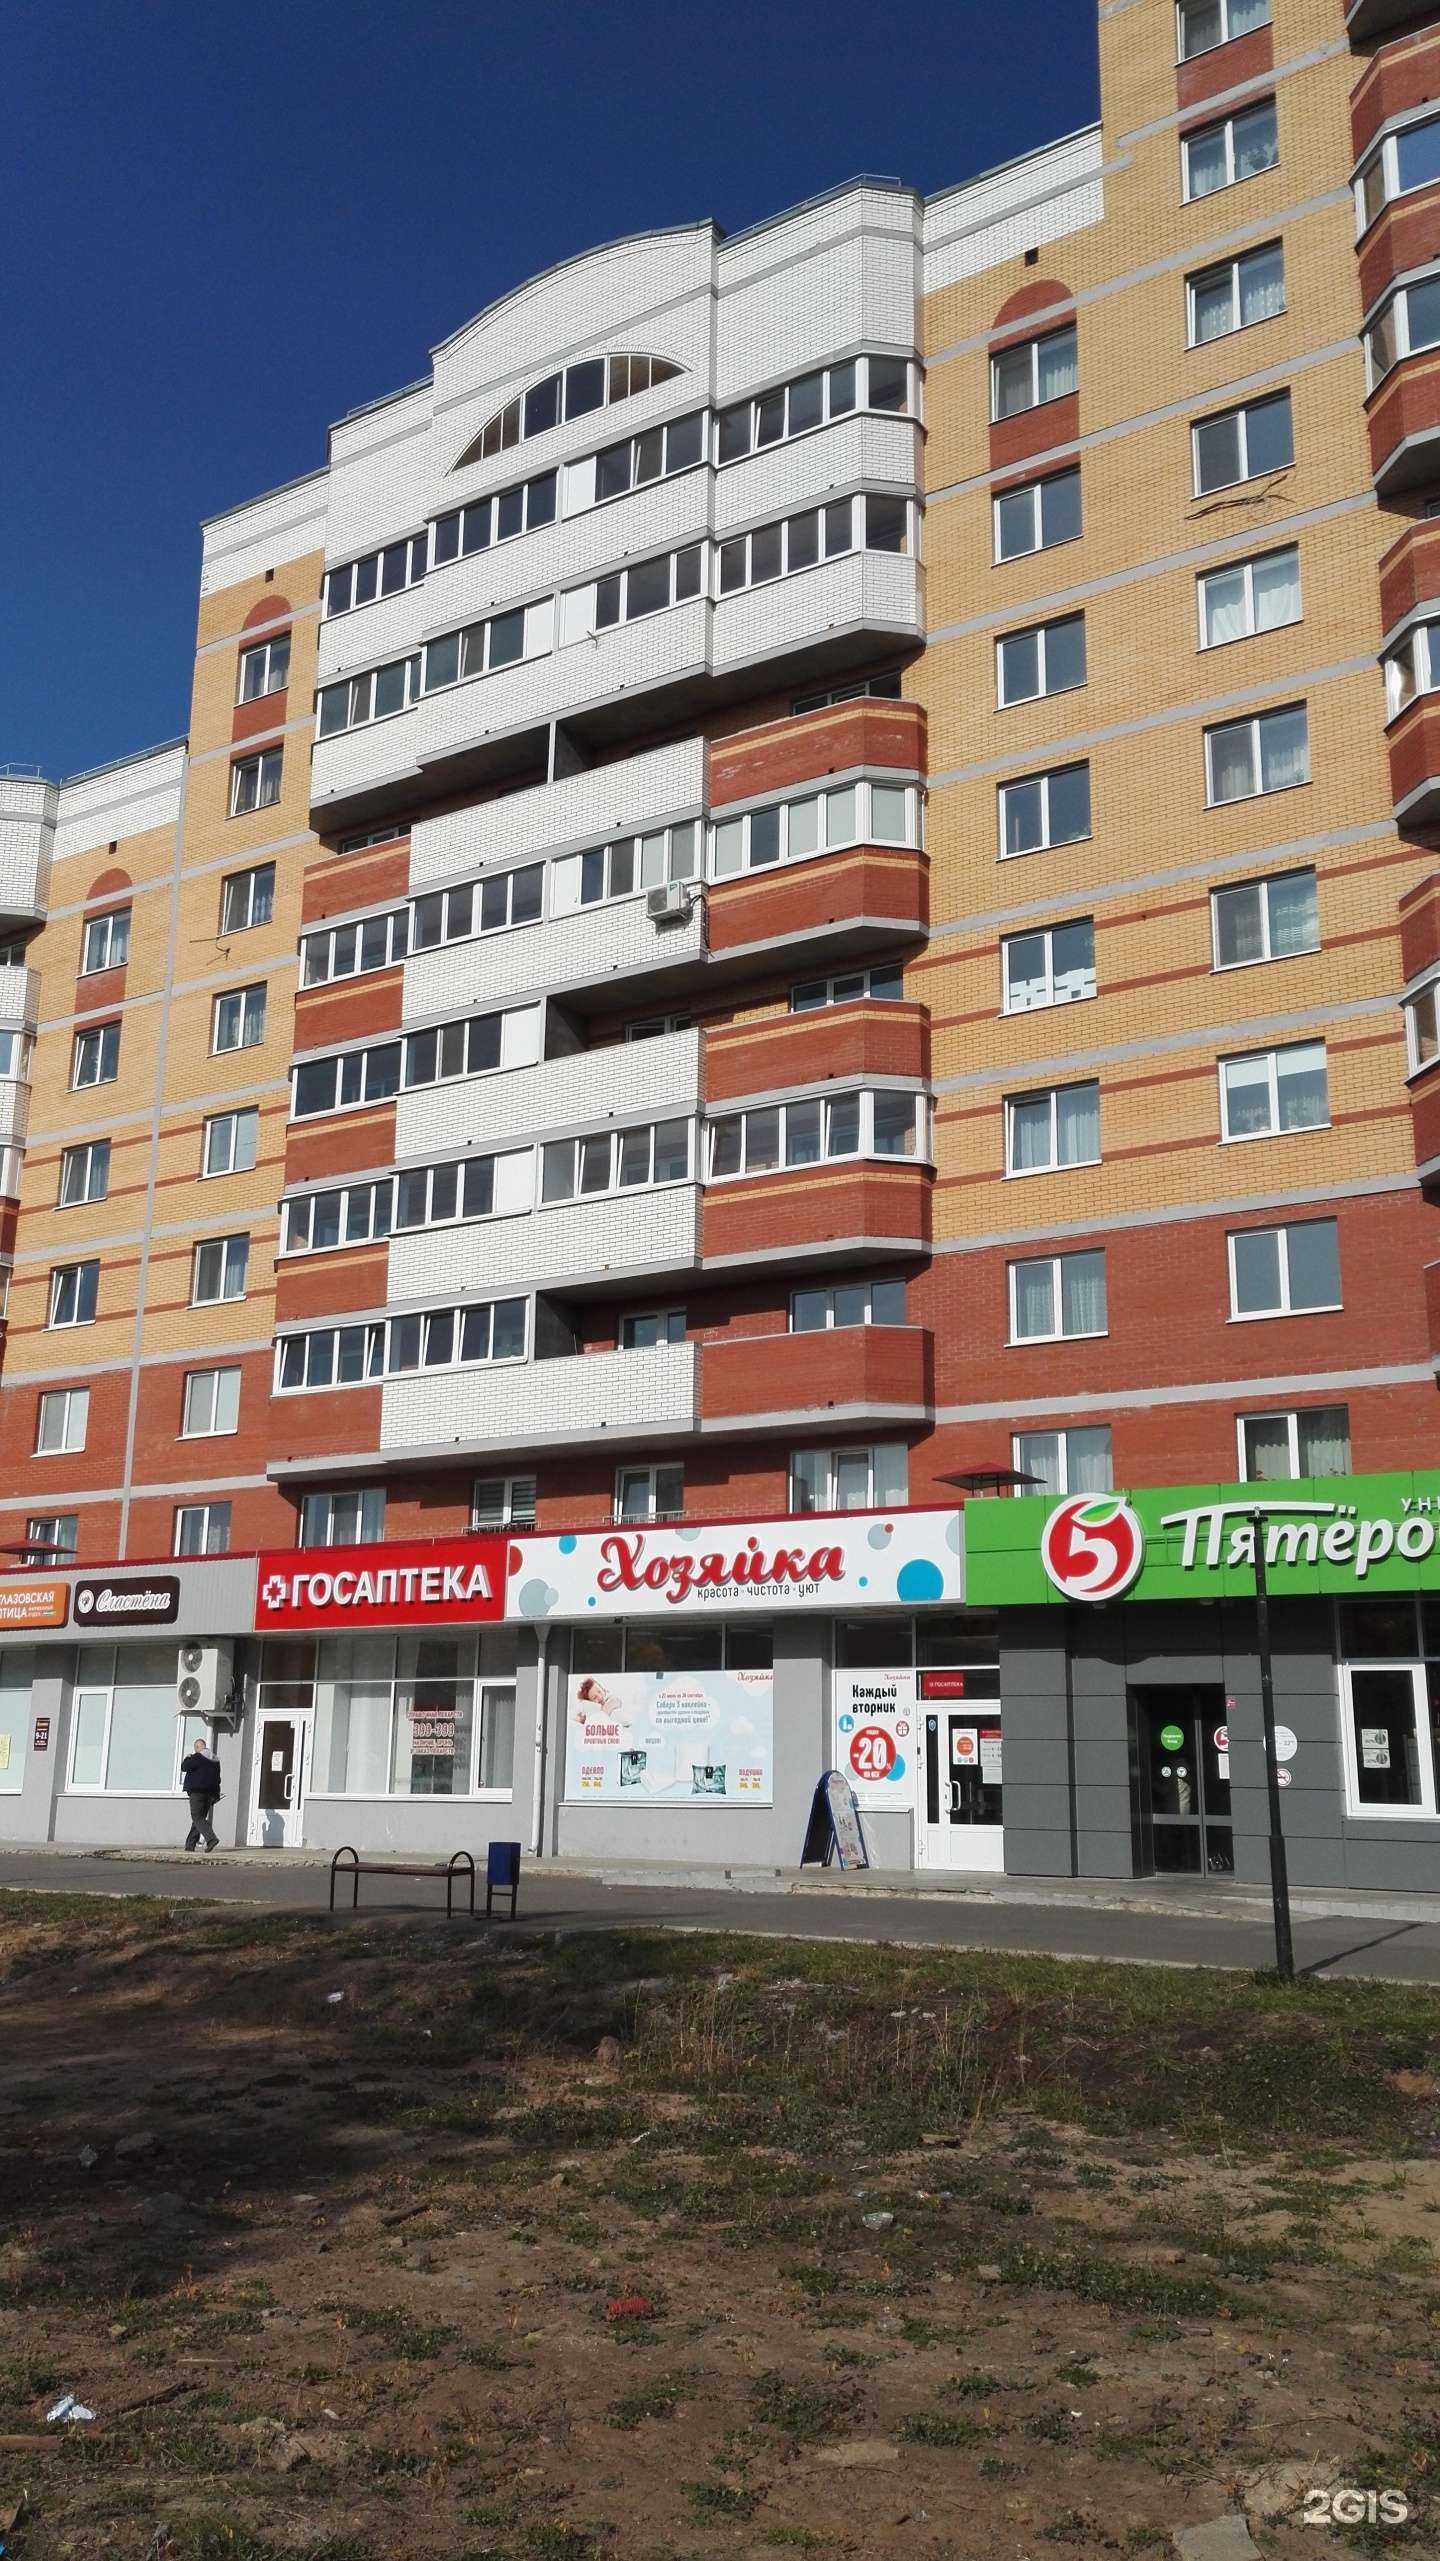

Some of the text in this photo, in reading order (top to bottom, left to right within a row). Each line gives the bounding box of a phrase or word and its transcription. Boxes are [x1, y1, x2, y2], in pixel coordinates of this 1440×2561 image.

[1401, 1496, 1440, 1512] УН
[597, 1534, 847, 1604] Хозяйка
[292, 1565, 492, 1608] ГОСАПТЕКА
[697, 1582, 821, 1602] красота чистота уют
[96, 1588, 171, 1613] Сластёна
[852, 1684, 897, 1699] Каждый
[852, 1703, 896, 1716] вторник
[35, 1731, 48, 1740] 9-21
[585, 1724, 620, 1737] БОЛЬШЕ
